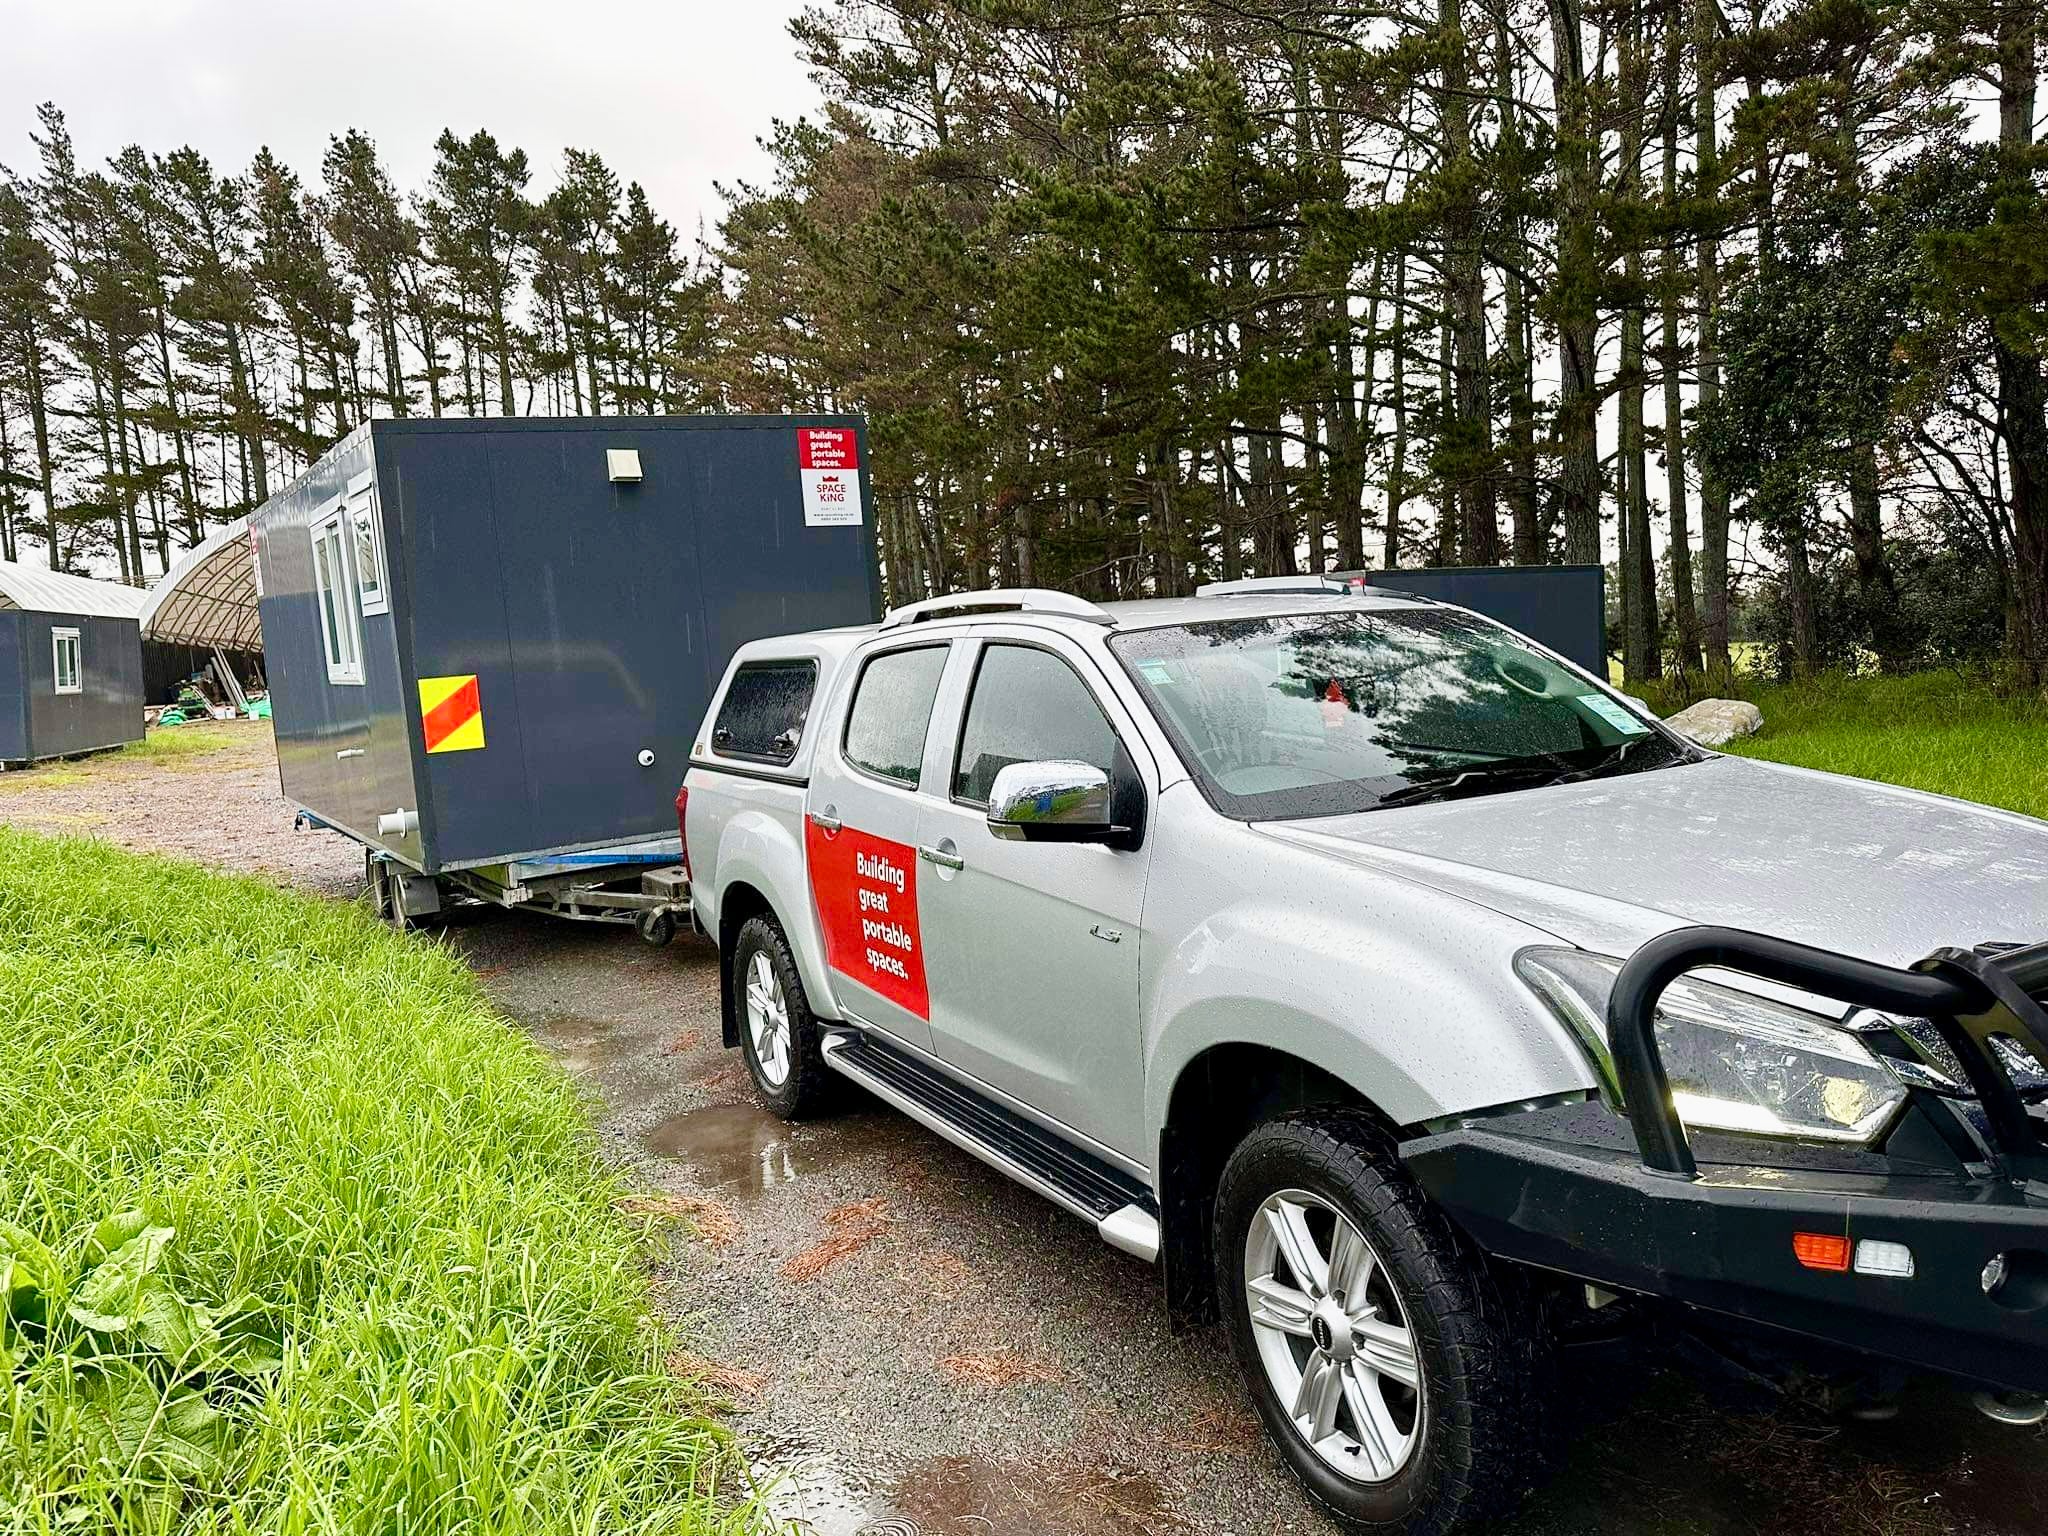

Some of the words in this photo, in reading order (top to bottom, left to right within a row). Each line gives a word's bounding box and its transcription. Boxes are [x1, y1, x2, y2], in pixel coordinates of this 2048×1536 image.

[809, 431, 843, 442] Building
[810, 441, 832, 450] great
[811, 449, 845, 459] portable
[812, 459, 841, 468] spaces.
[816, 484, 846, 493] SPACE
[856, 851, 905, 894] Building
[858, 887, 889, 913] great
[862, 918, 912, 952] portable
[866, 946, 909, 981] spaces.
